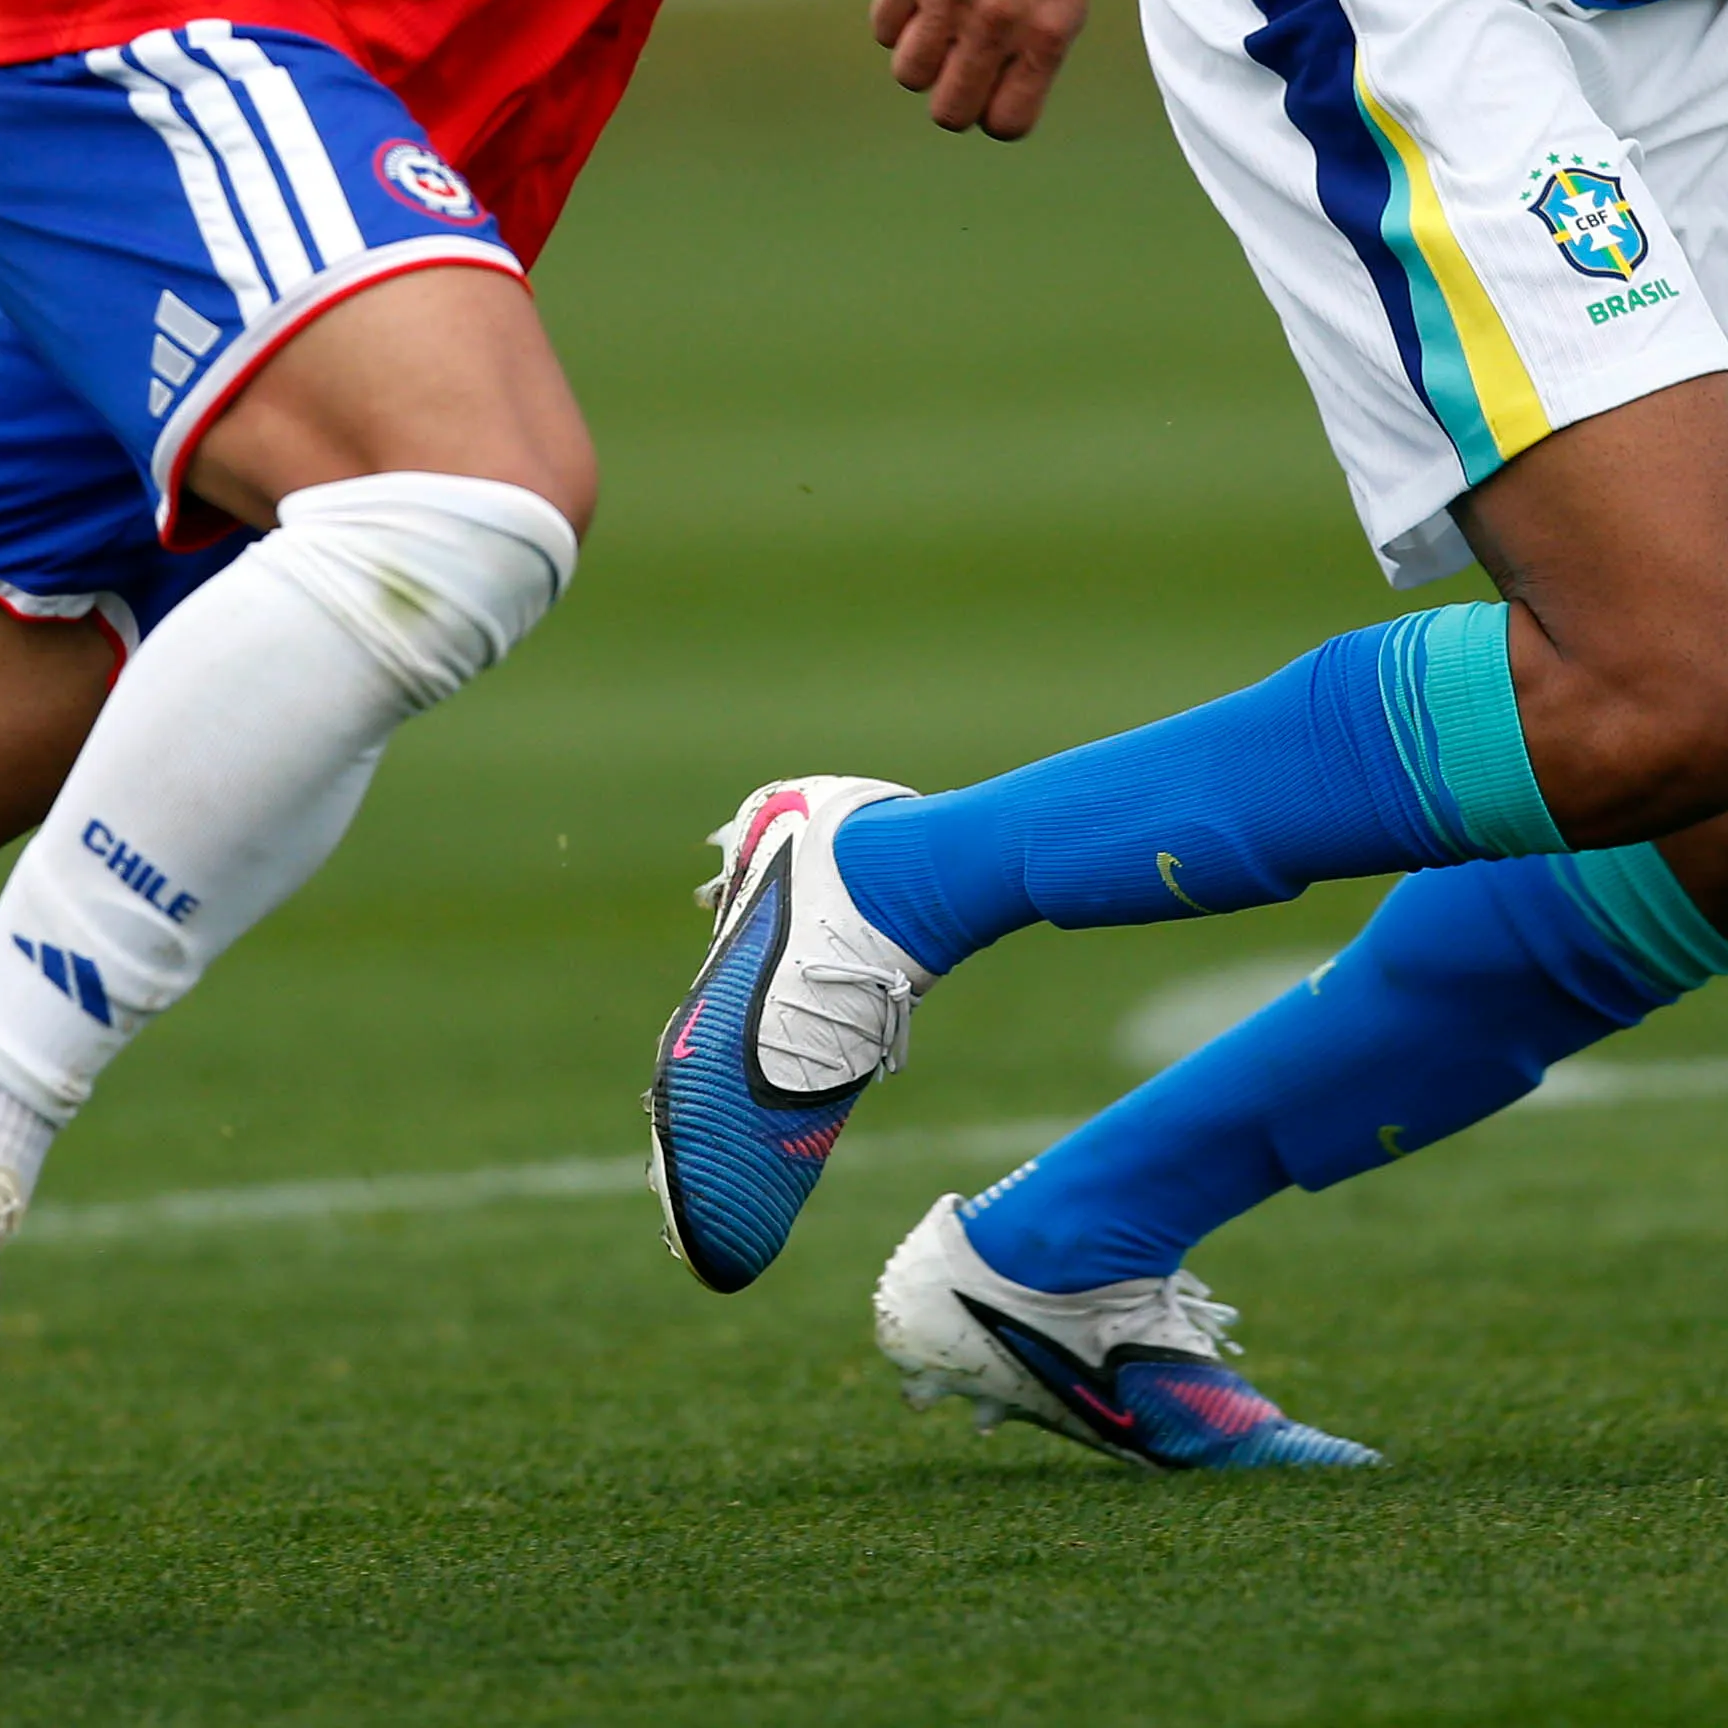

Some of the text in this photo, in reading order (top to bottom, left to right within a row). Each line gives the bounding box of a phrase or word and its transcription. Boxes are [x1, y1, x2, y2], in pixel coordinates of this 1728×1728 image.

[1574, 210, 1609, 232] CBF
[1585, 277, 1680, 326] BRASIL
[81, 817, 202, 925] CHILE
